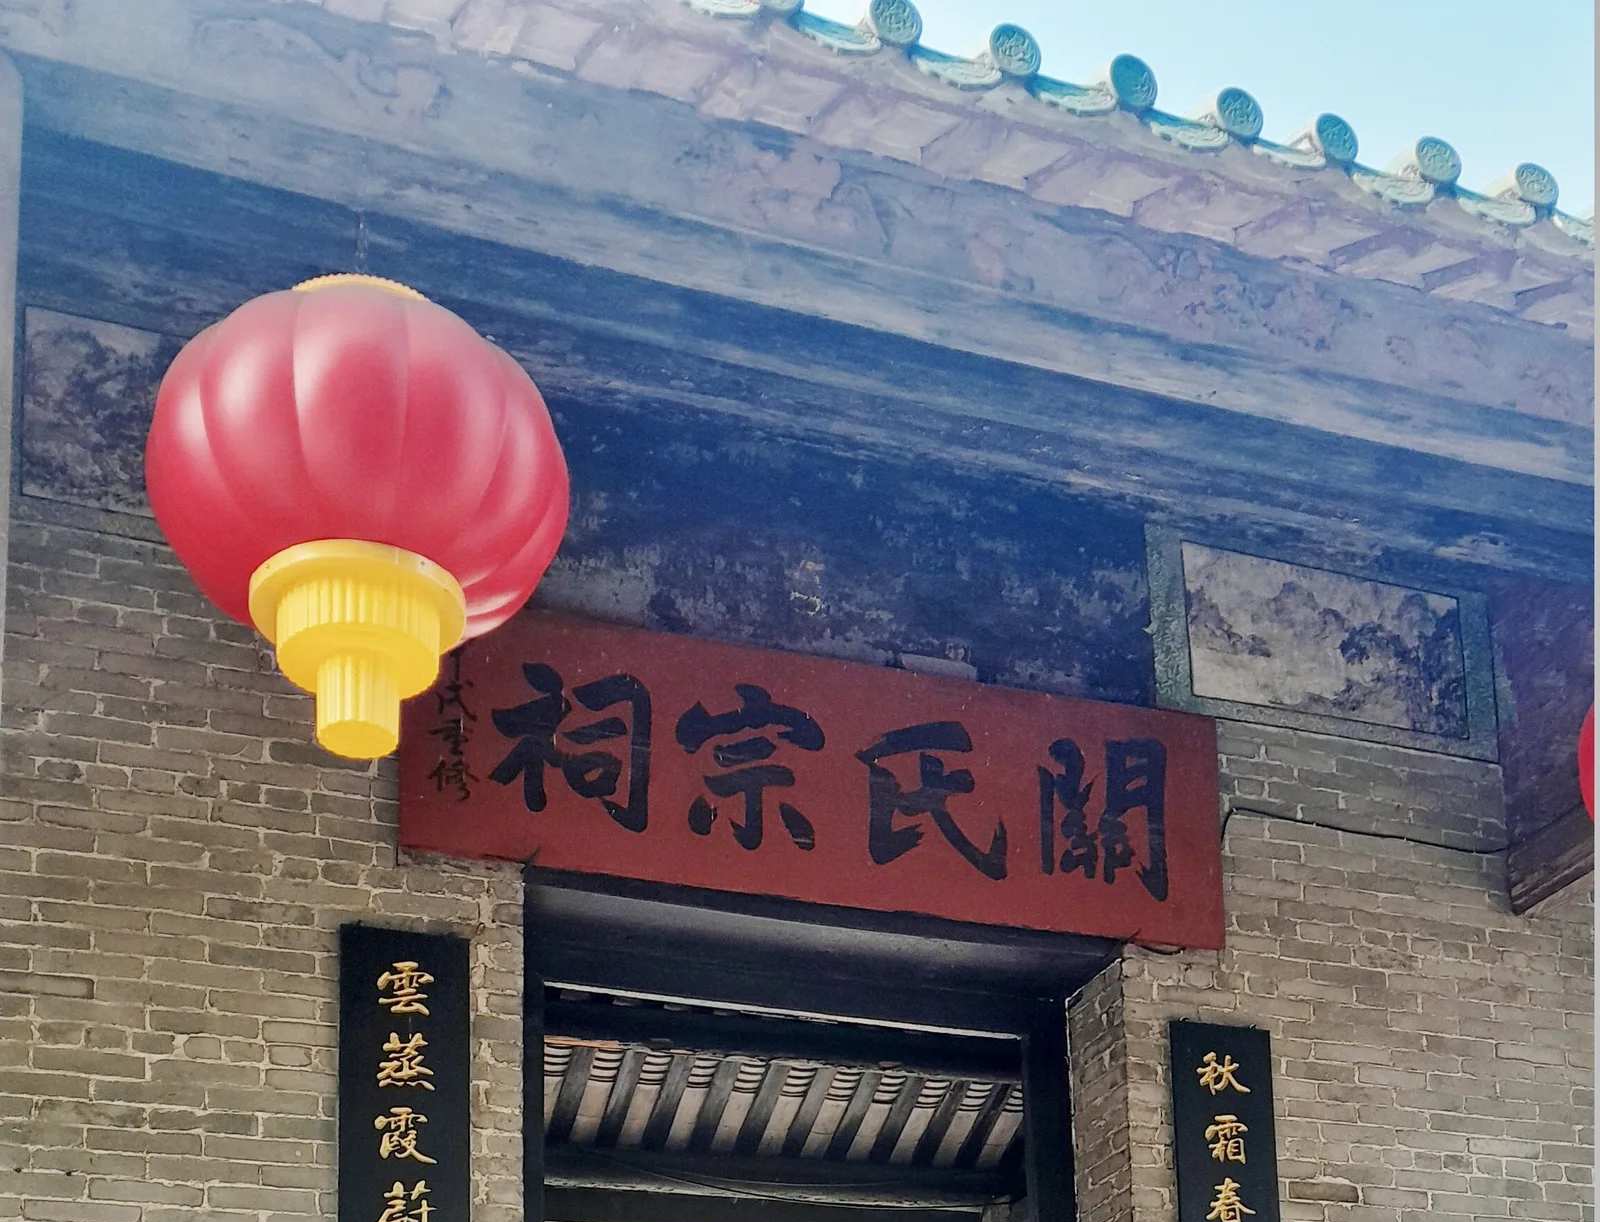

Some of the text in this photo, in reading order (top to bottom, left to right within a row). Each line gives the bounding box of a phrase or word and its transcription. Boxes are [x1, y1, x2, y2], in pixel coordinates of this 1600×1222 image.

[427, 650, 481, 803] 戌重修
[489, 661, 1170, 902] 關氏宗祠
